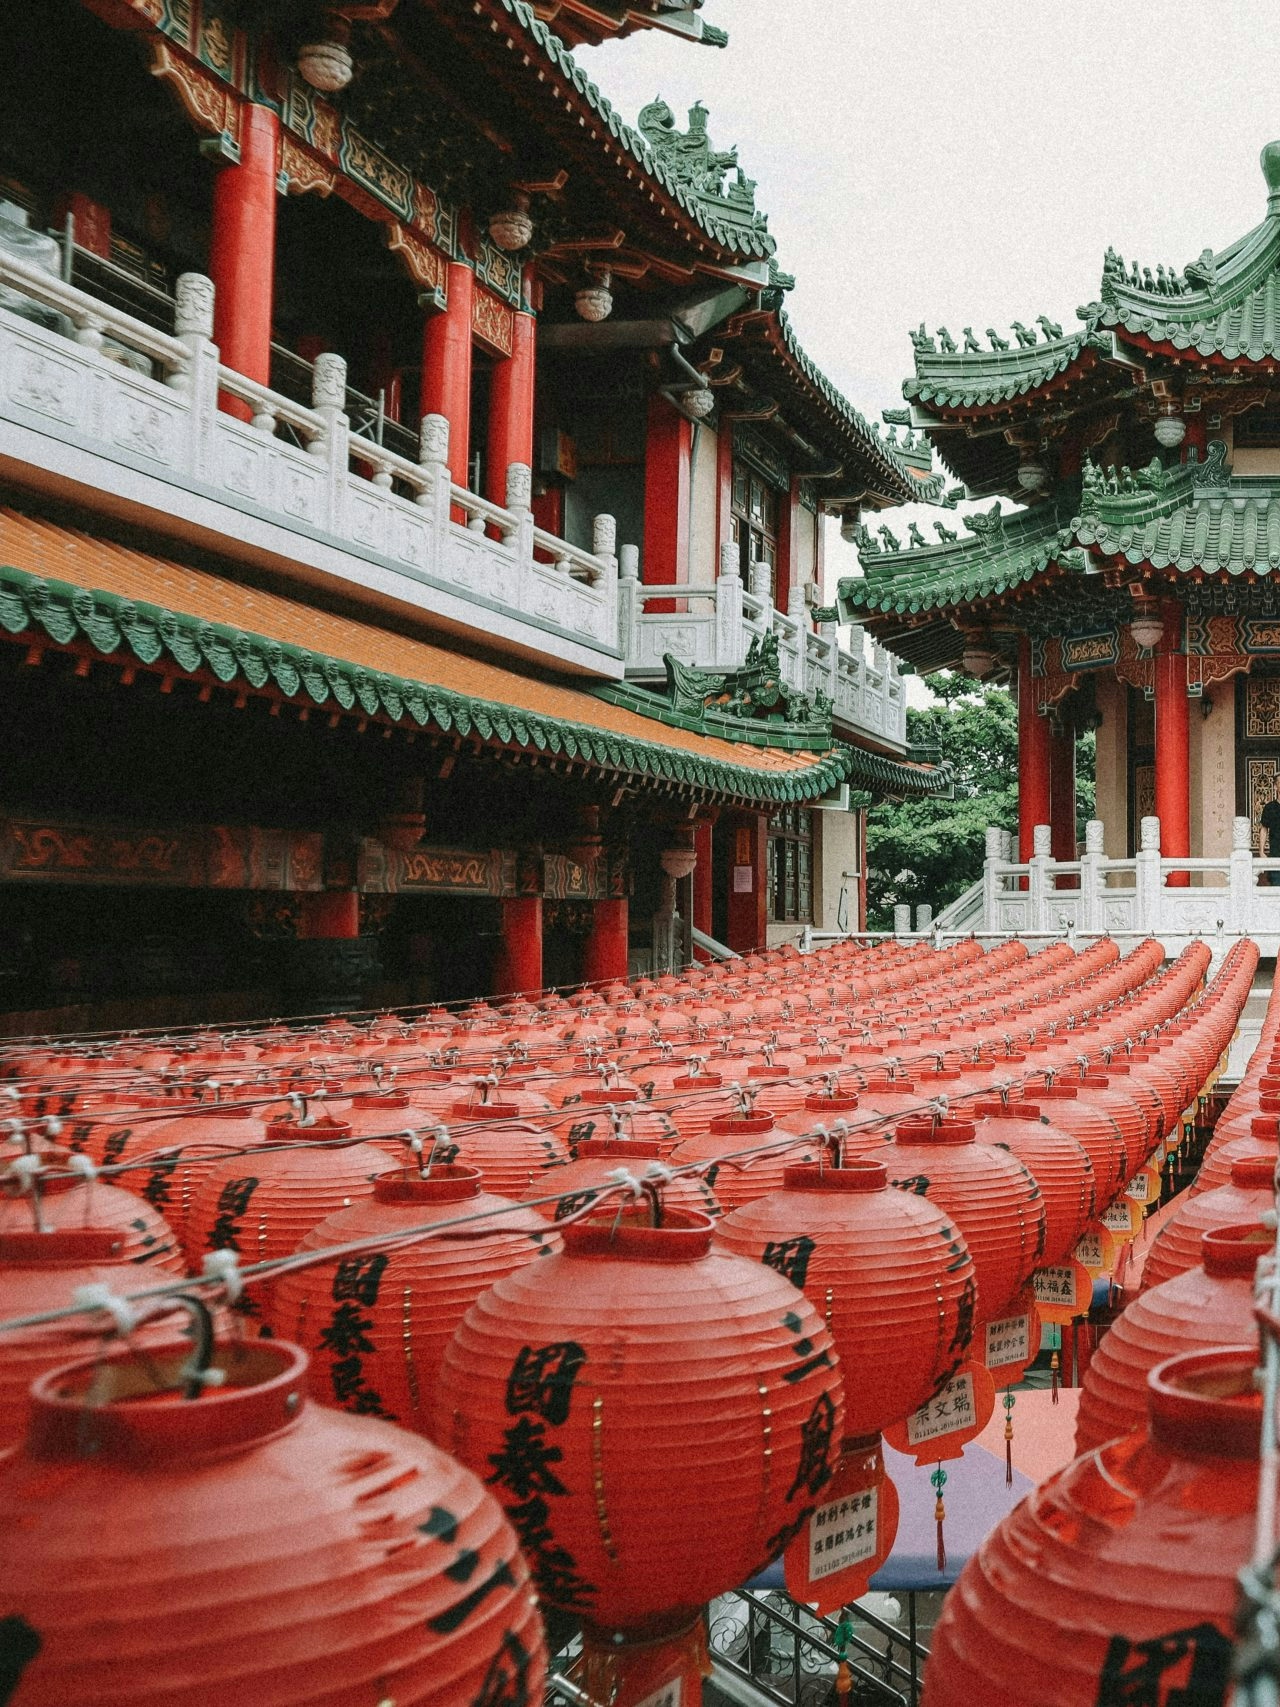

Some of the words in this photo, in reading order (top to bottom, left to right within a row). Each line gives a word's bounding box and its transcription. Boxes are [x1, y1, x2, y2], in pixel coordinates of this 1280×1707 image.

[1034, 1278, 1074, 1296] 林福鑫
[815, 1494, 872, 1528] 財利平安燈
